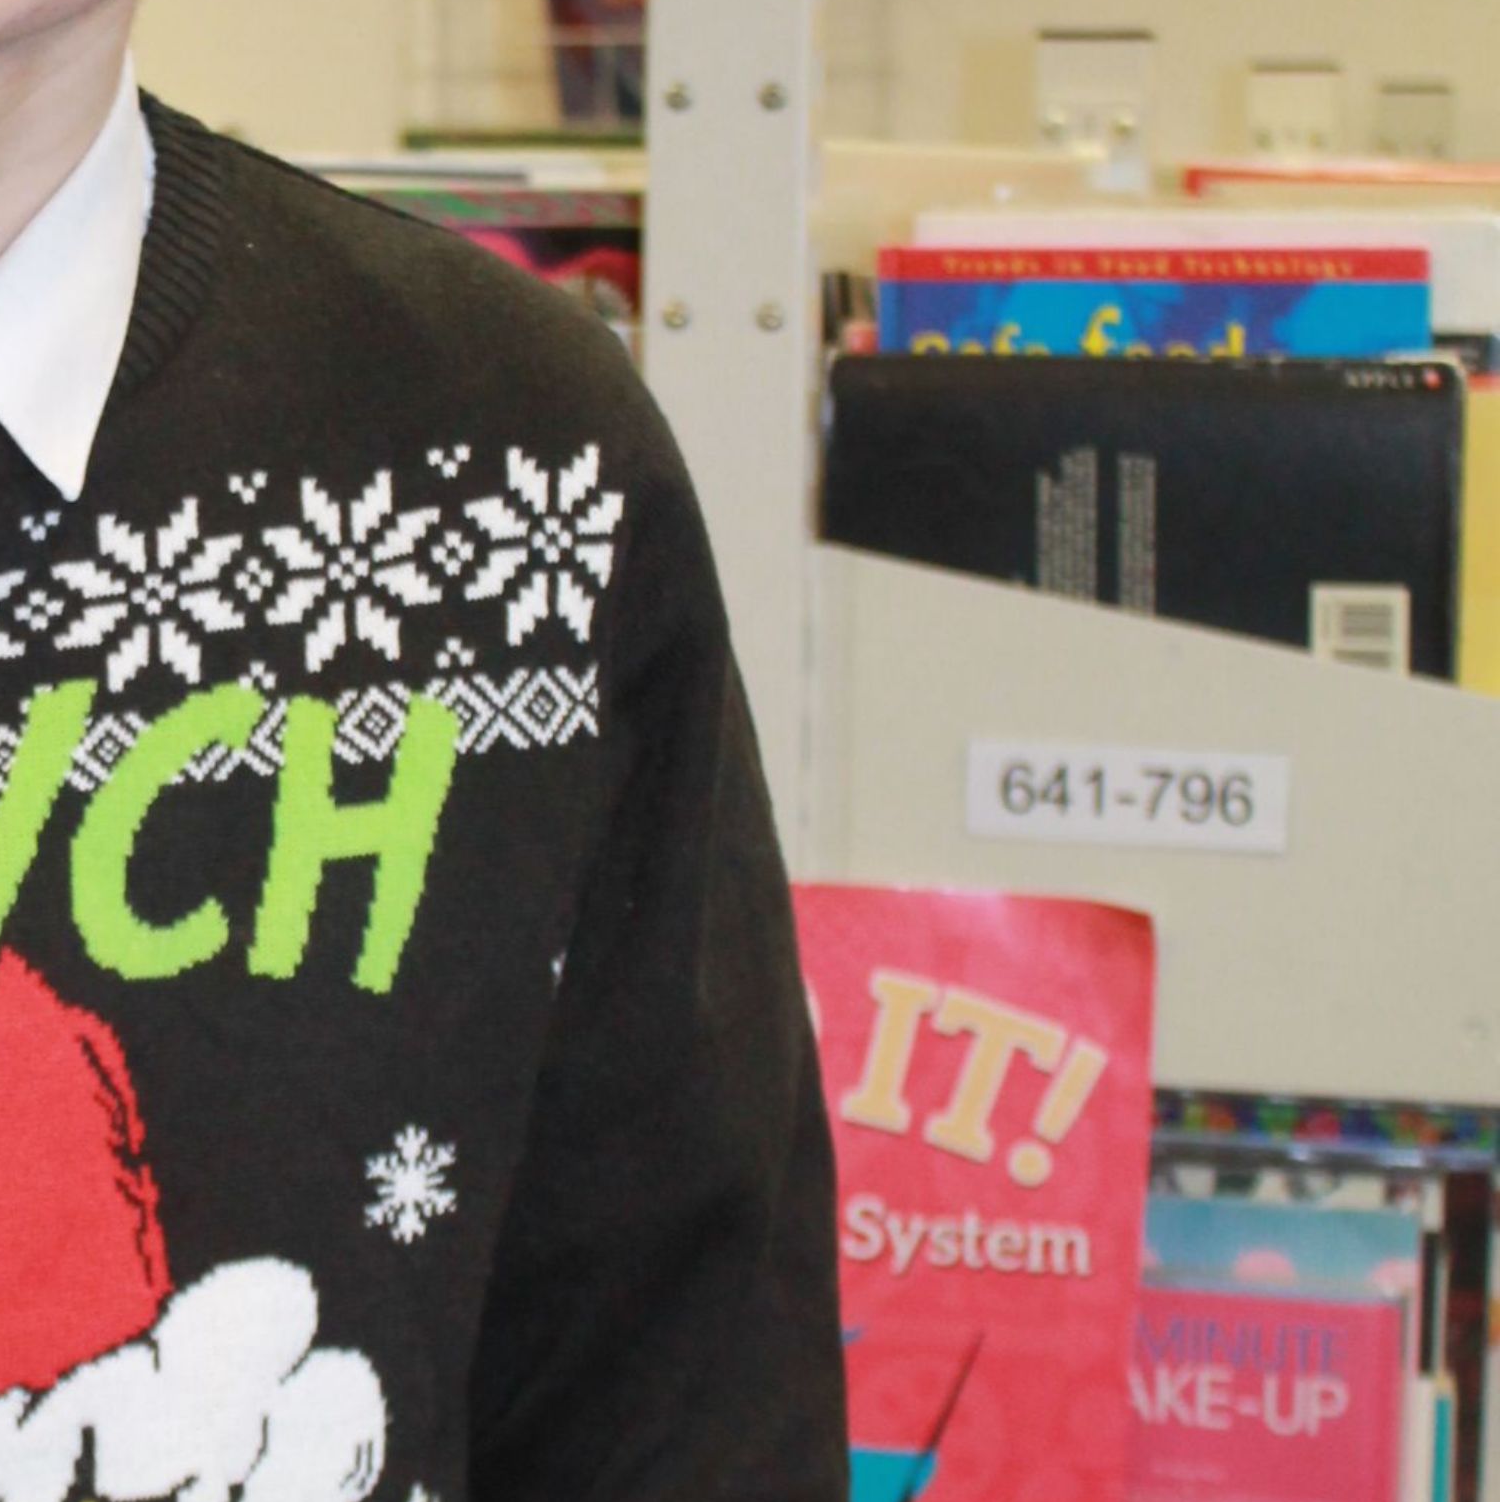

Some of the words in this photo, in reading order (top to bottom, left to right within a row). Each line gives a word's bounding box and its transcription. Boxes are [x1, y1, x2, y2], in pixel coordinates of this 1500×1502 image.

[1000, 763, 1255, 826] 641-796
[840, 967, 1108, 1188] IT!
[843, 1195, 1090, 1275] System
